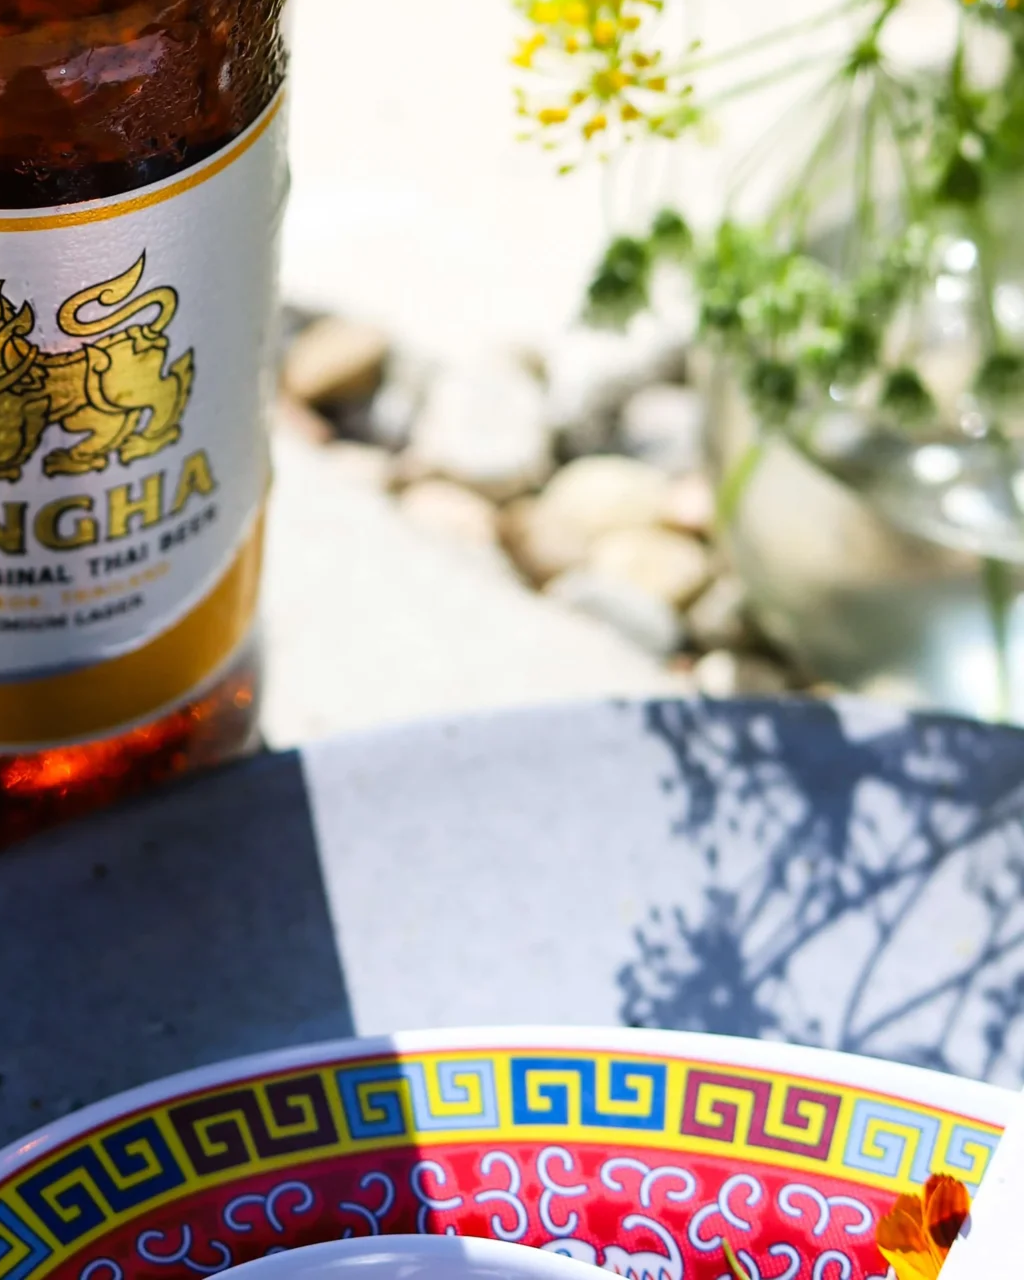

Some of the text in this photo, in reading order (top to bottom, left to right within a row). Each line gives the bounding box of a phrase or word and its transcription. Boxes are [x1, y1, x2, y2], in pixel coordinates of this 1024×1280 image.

[87, 544, 148, 578] THAI
[159, 505, 217, 551] BEER
[75, 593, 144, 628] LAGER
